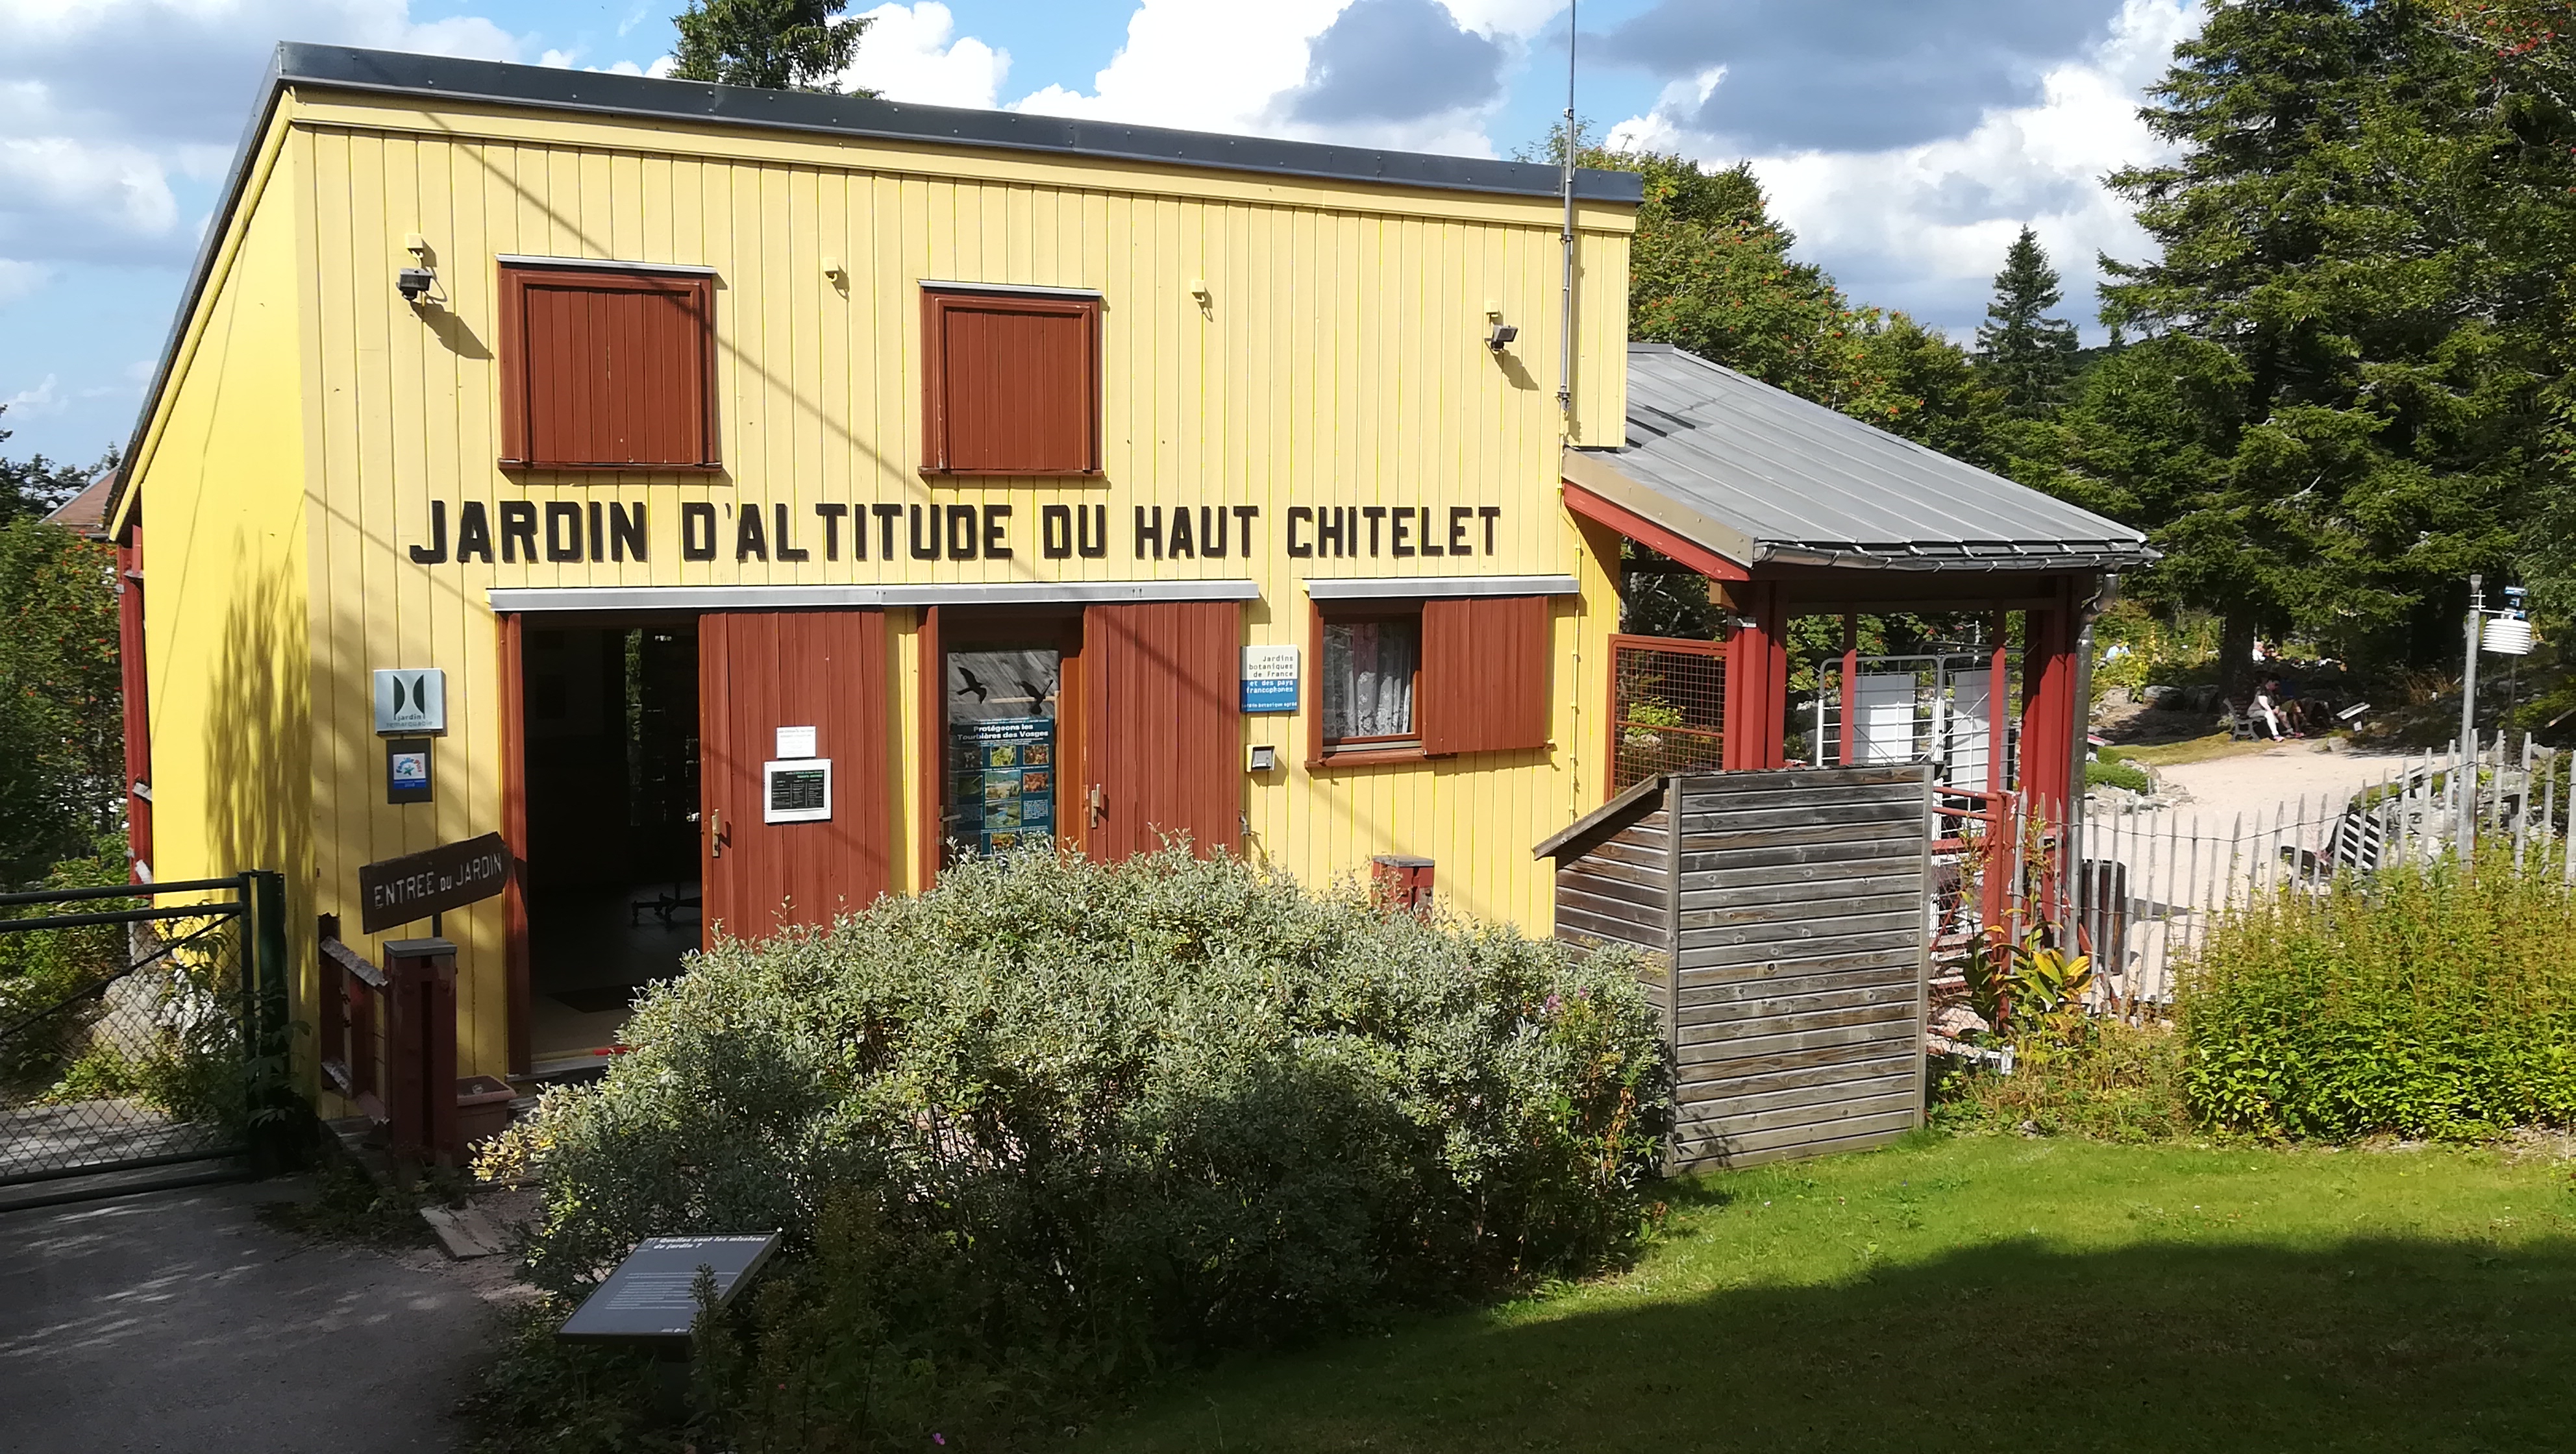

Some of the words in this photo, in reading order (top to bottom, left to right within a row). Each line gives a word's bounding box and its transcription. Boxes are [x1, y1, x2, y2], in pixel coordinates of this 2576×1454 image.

[409, 500, 649, 563] JARDIN
[682, 502, 1013, 562] D'ALTITUDE
[1043, 504, 1107, 560] DU
[1135, 505, 1259, 560] HAUT
[1287, 506, 1500, 559] CHITELET
[974, 724, 1020, 733] Protégeons
[440, 876, 452, 892] DU
[456, 853, 502, 887] JARDIN
